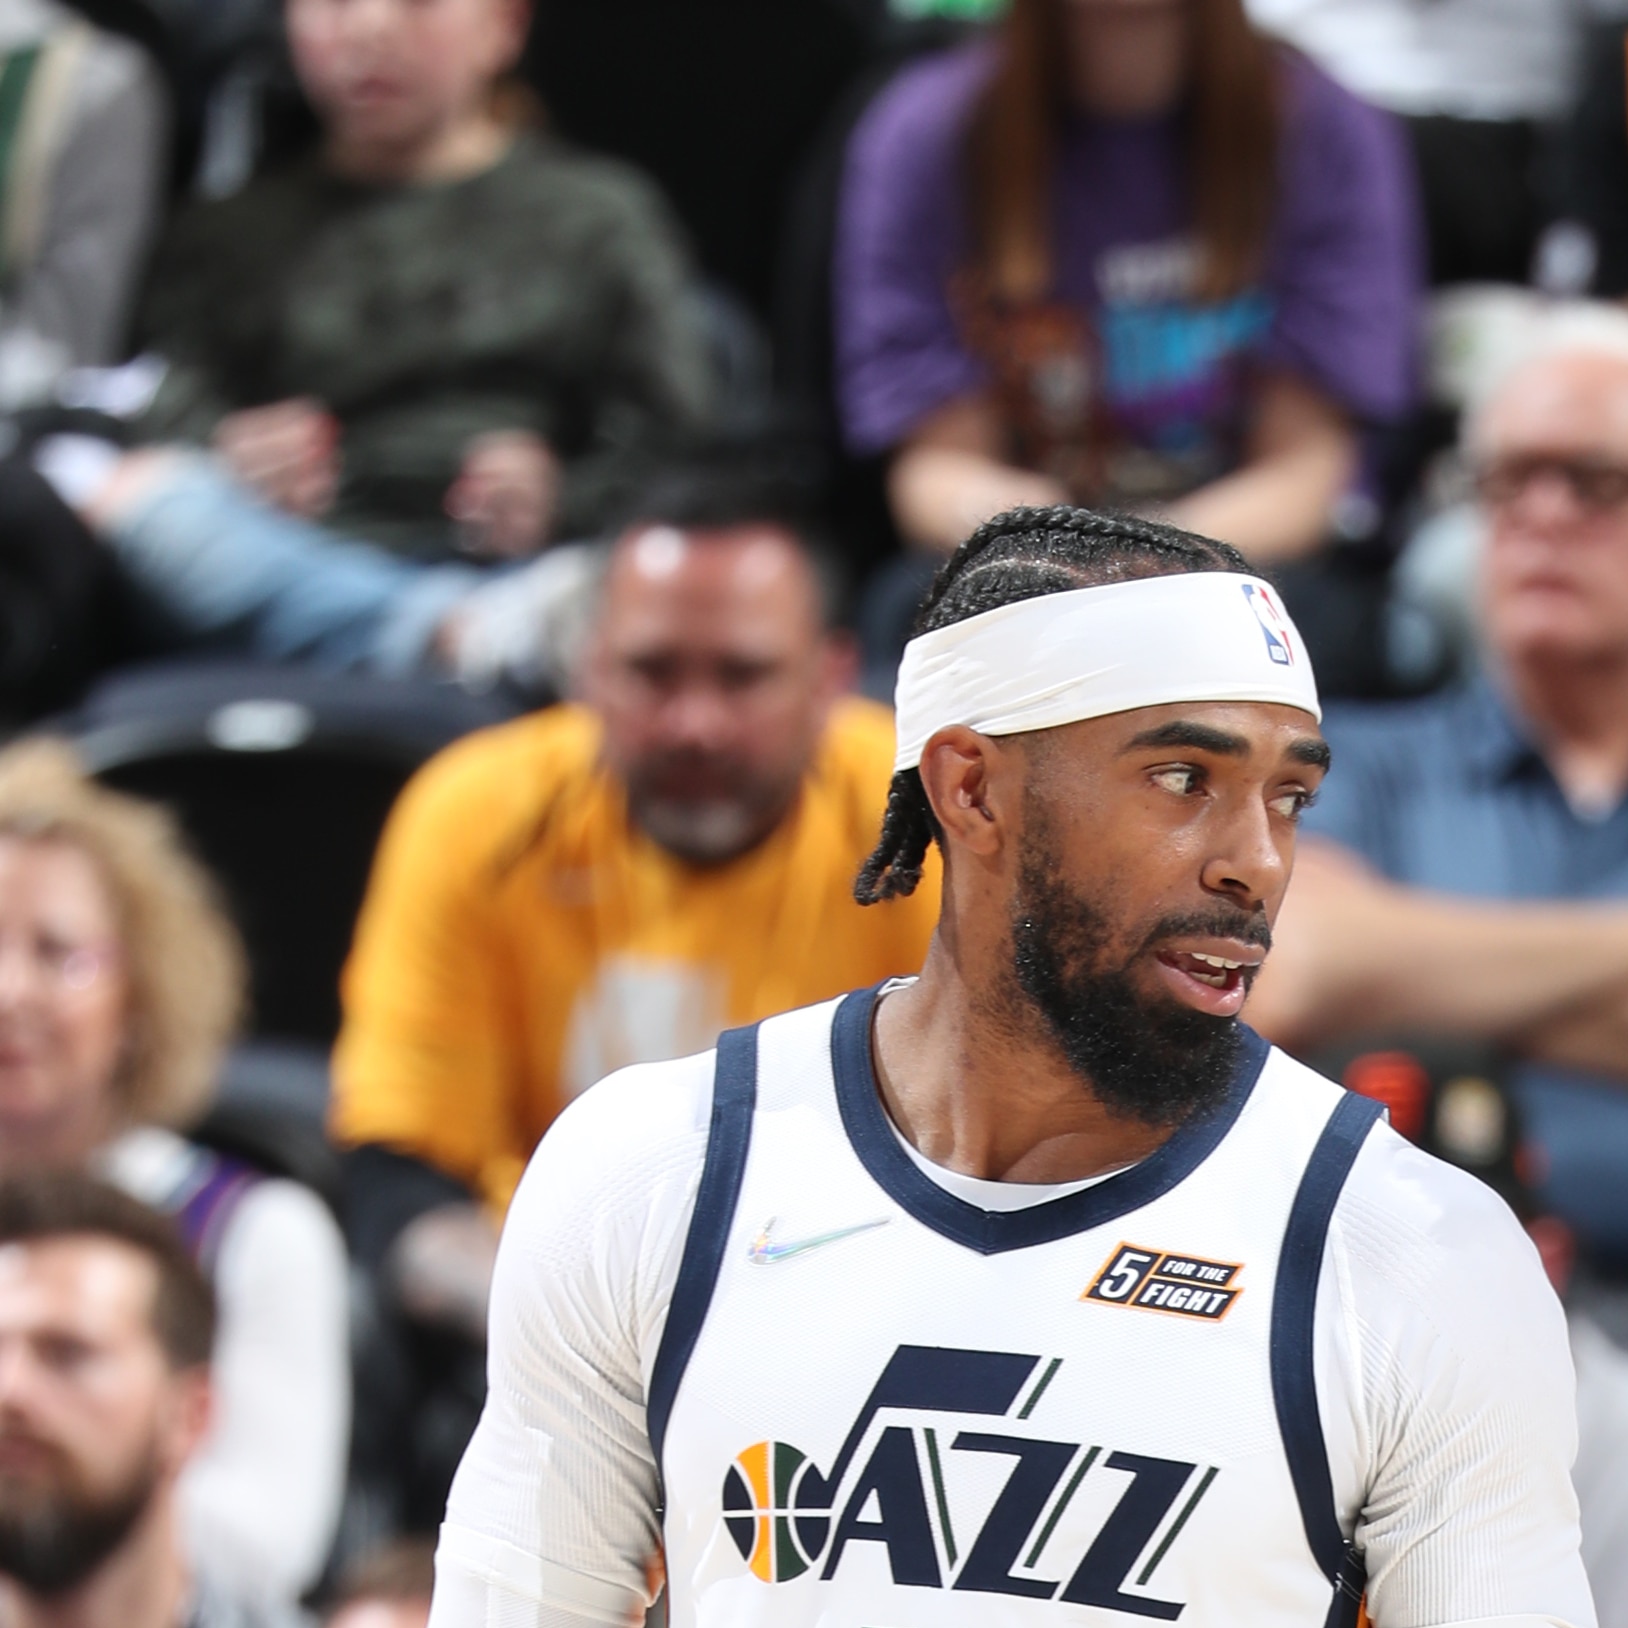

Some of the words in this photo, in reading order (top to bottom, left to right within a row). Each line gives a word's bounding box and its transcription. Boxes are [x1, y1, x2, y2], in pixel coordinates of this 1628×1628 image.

[1098, 1251, 1151, 1299] 5
[1162, 1259, 1197, 1276] FOR
[1197, 1265, 1230, 1282] THE
[1139, 1282, 1229, 1314] FIGHT
[722, 1344, 1221, 1622] JAZZ
